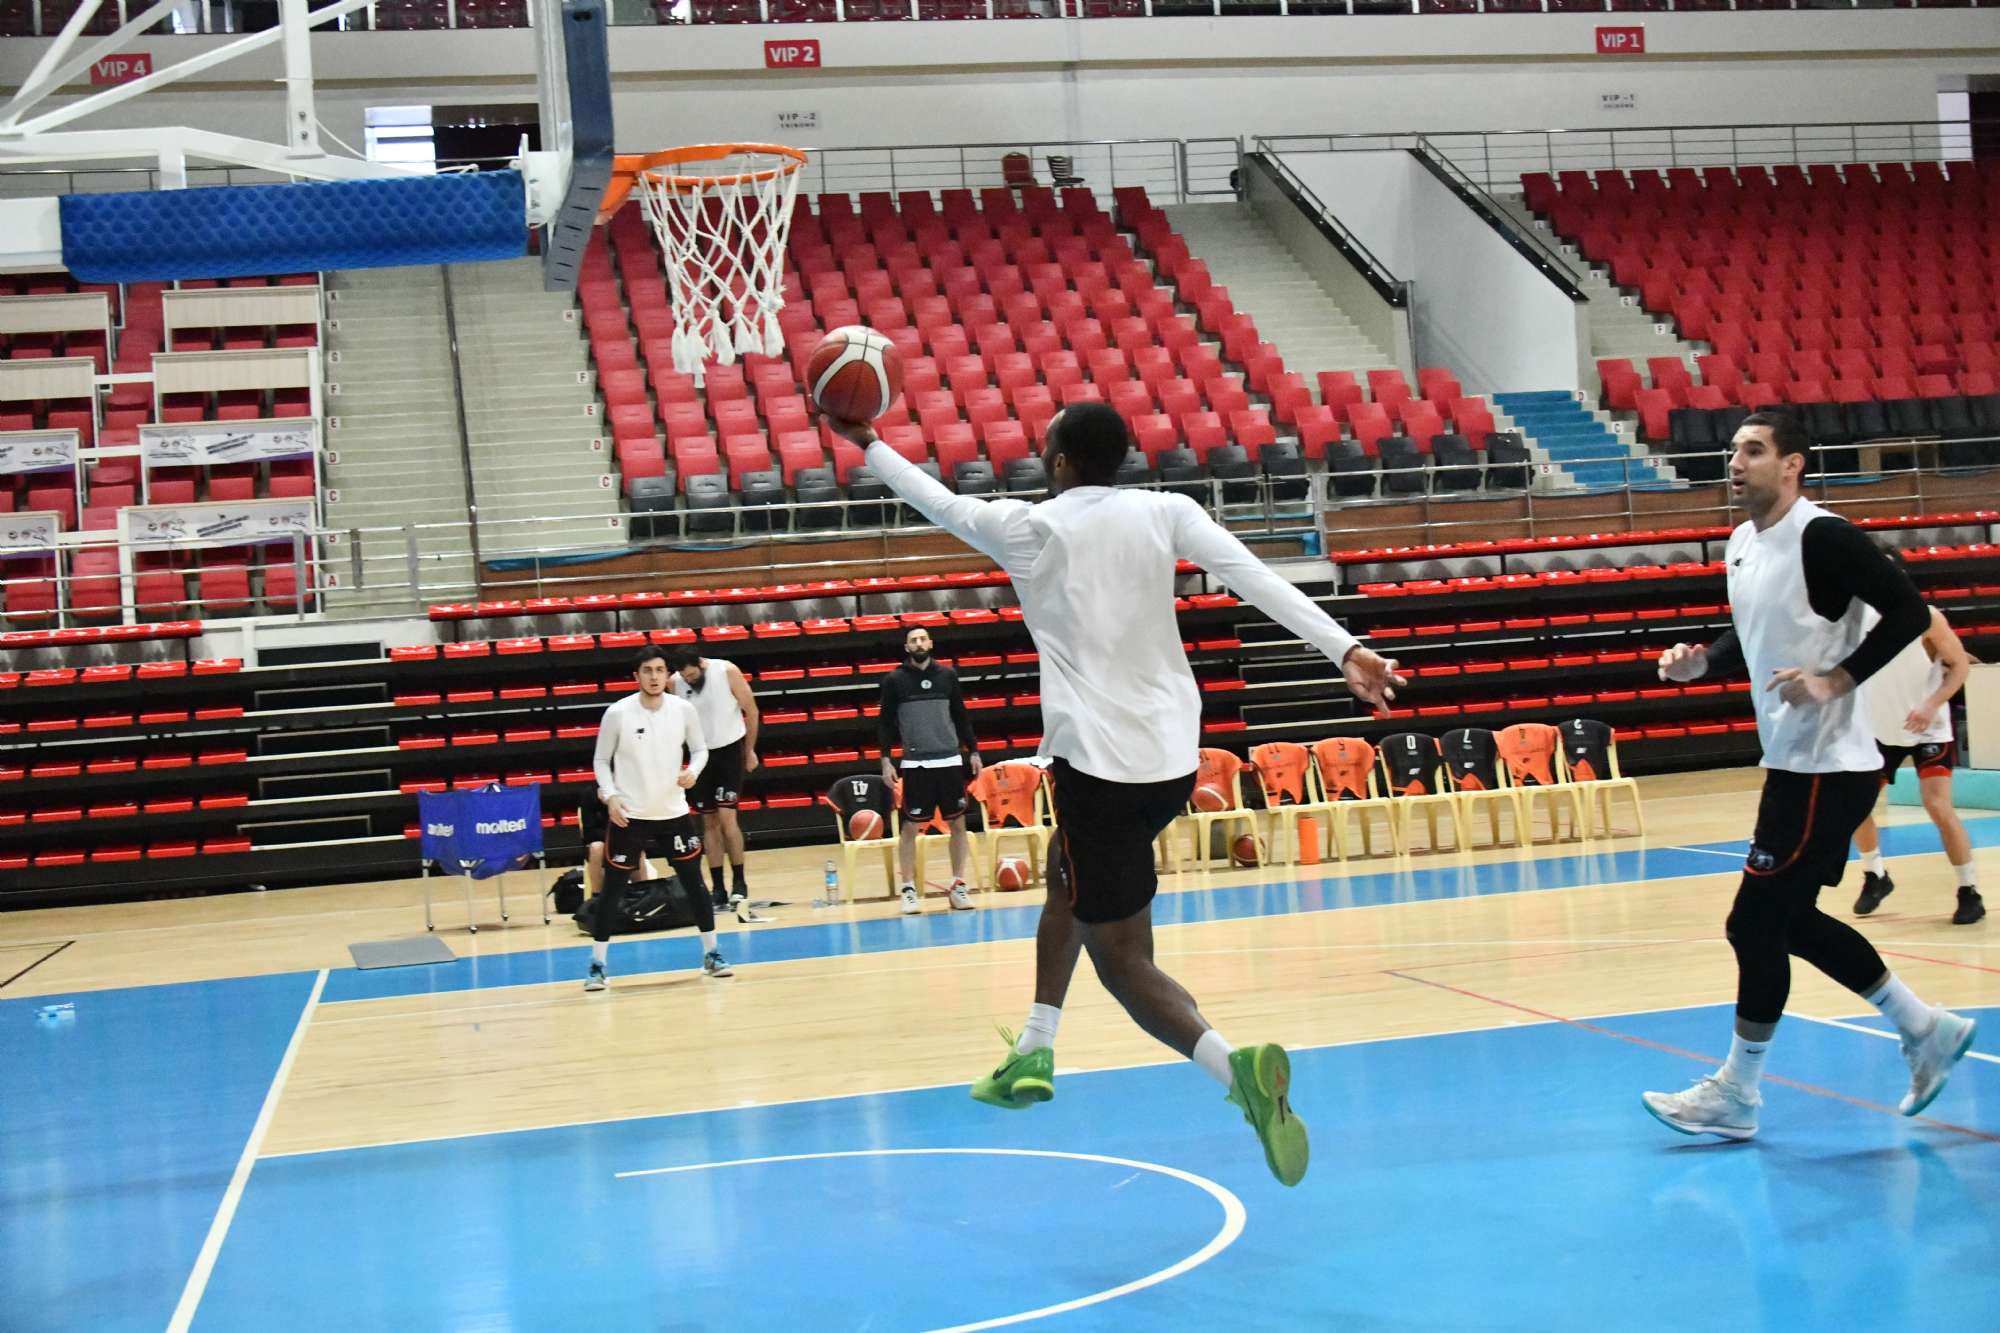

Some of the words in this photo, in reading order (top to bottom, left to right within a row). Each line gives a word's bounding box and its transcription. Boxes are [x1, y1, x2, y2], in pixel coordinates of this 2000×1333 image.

[1601, 33, 1626, 48] VIP
[1630, 33, 1640, 47] 1
[770, 46, 799, 62] VIP
[803, 45, 815, 61] 2
[97, 60, 128, 77] VIP
[133, 59, 146, 76] 4
[778, 113, 799, 121] VIP
[332, 352, 338, 362] G
[580, 373, 586, 382] F
[331, 385, 337, 394] F
[1578, 391, 1584, 401] D
[588, 405, 593, 415] E
[331, 418, 337, 428] E
[1614, 423, 1620, 433] C
[594, 440, 601, 450] D
[329, 452, 336, 463] D
[603, 476, 610, 488] C
[330, 490, 337, 501] C
[329, 575, 336, 587] A
[1463, 729, 1471, 743] 7
[1406, 735, 1416, 750] 0
[993, 765, 1010, 780] 14
[851, 780, 869, 795] 41
[476, 818, 527, 834] molten
[674, 835, 686, 853] 4
